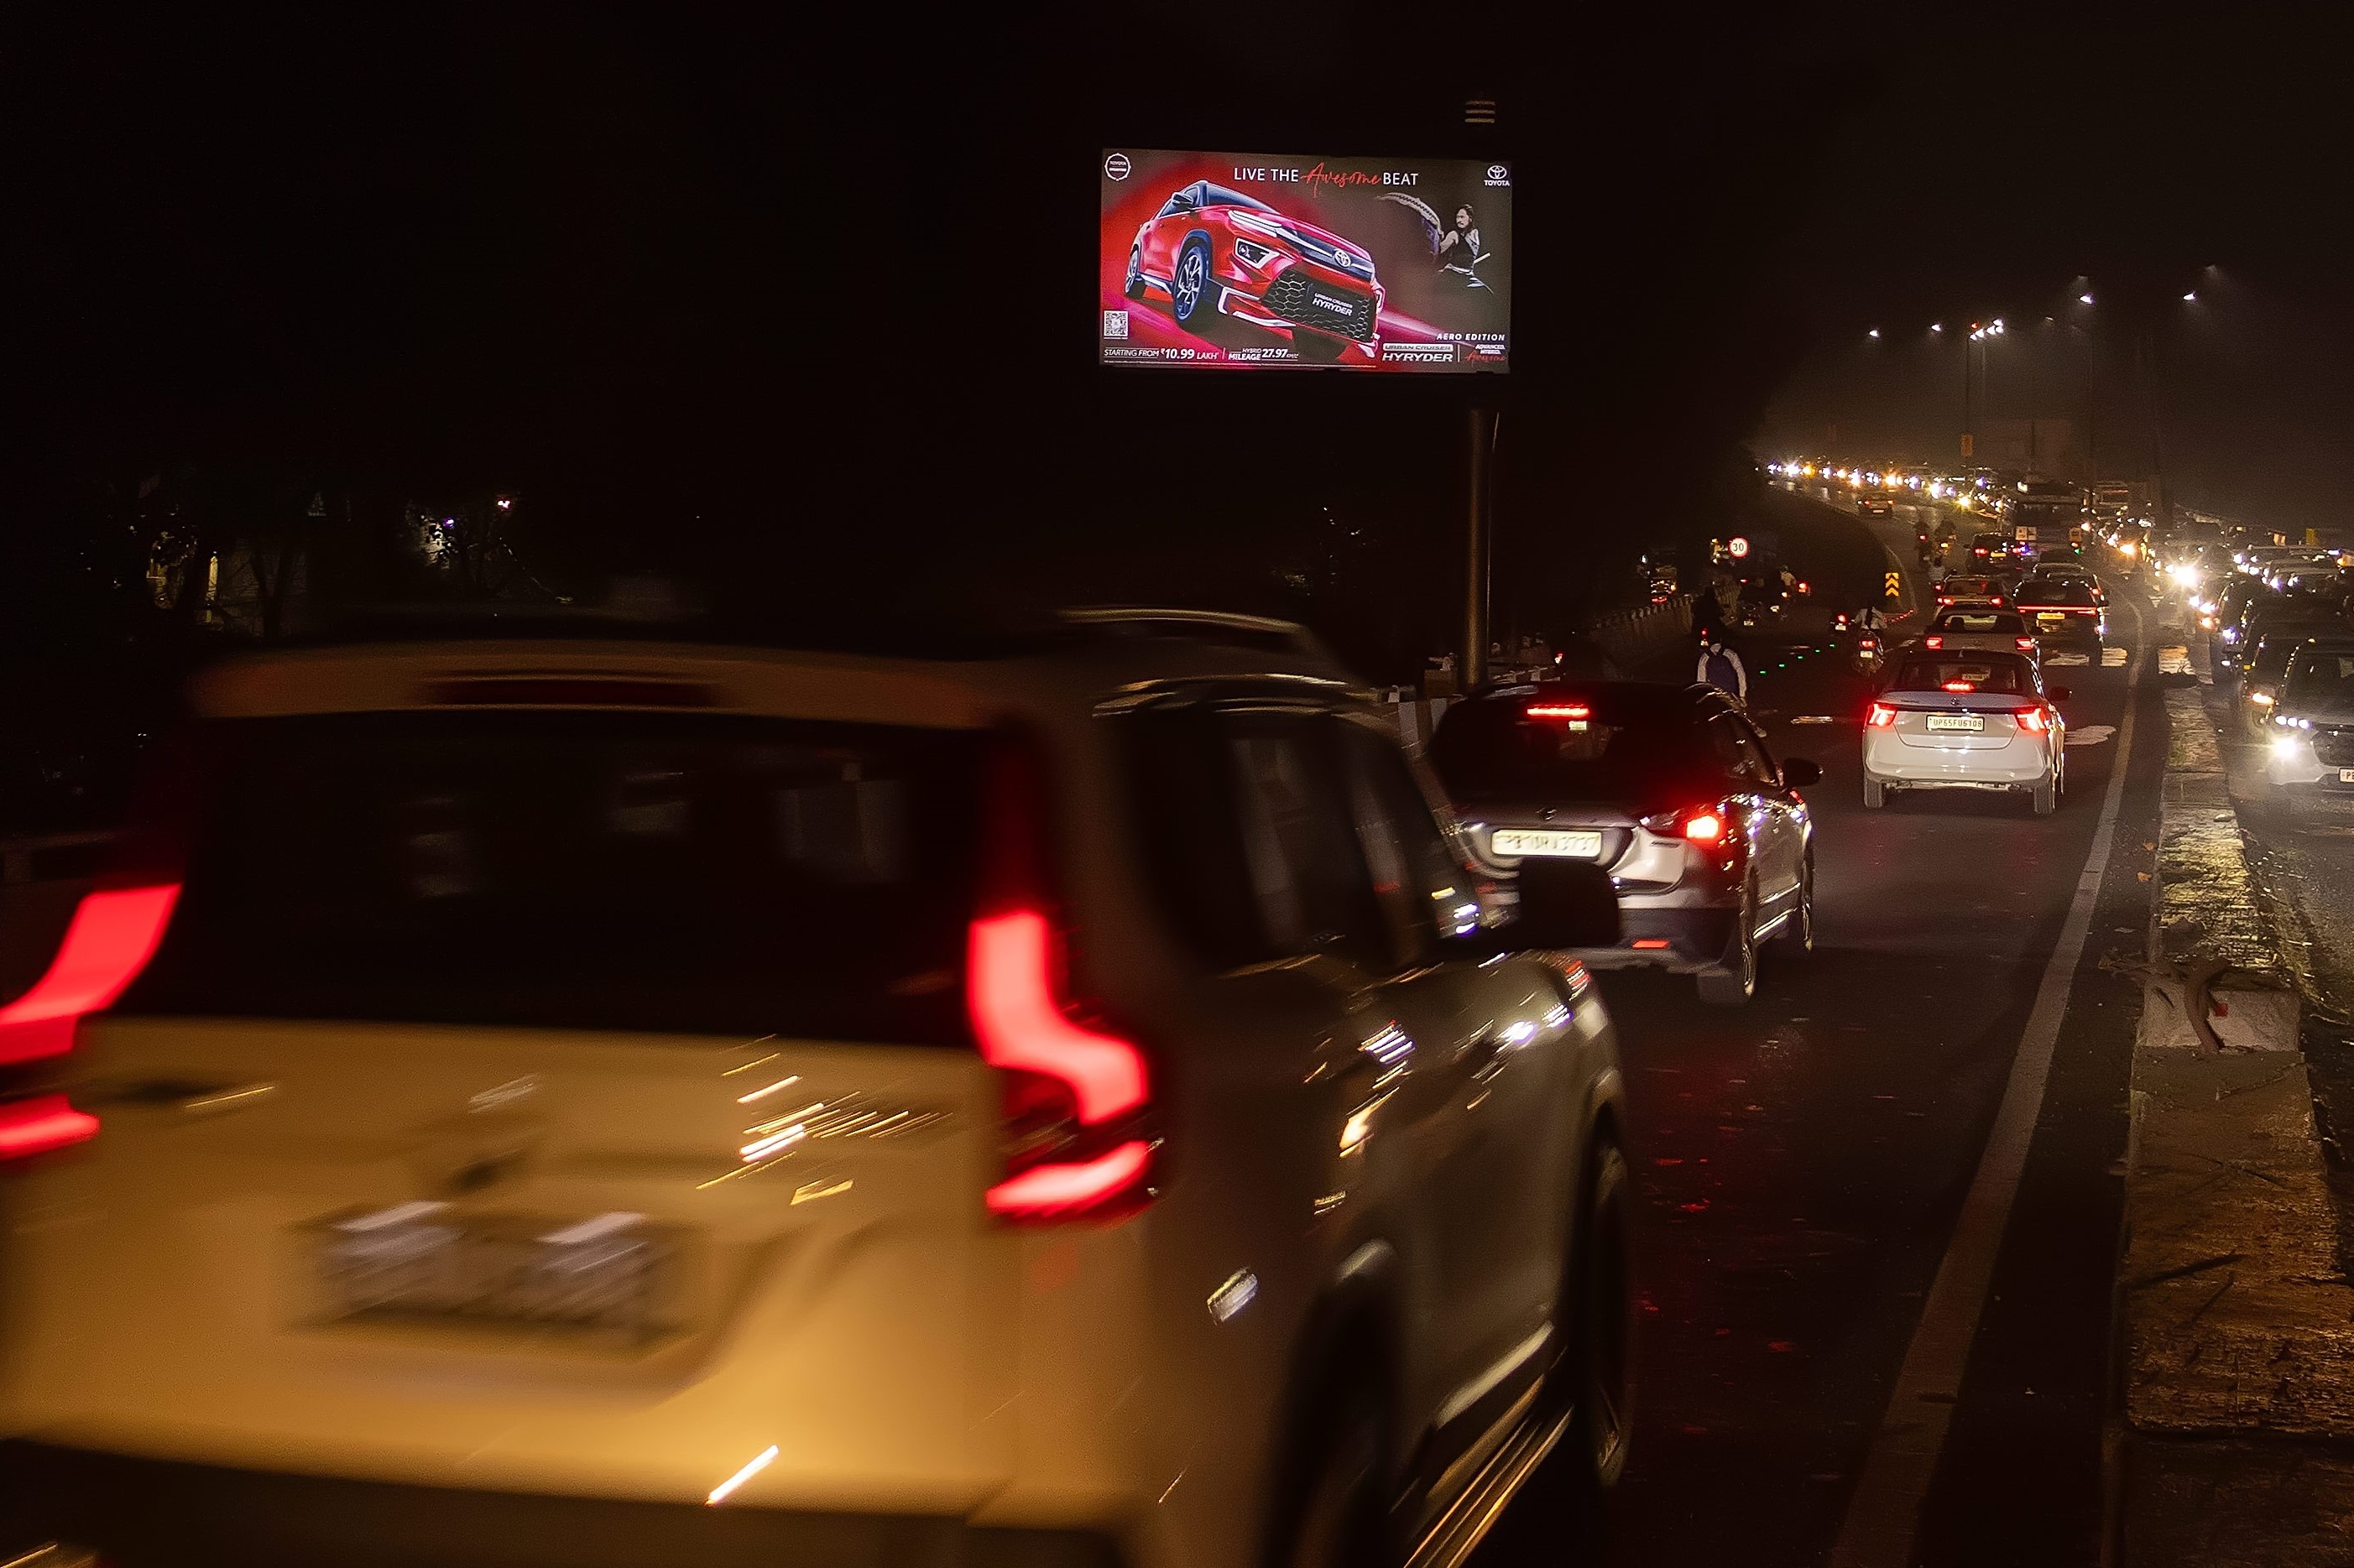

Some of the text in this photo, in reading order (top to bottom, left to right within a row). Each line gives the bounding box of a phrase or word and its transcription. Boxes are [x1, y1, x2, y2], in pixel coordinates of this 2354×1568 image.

[1234, 162, 1419, 199] LIVE THE Awesome BEAT
[1312, 298, 1353, 316] HYRYDER
[1436, 332, 1506, 341] AERO EDITION
[1261, 348, 1288, 358] 27.97
[1381, 352, 1454, 362] HYRYDER
[1733, 542, 1745, 552] 30
